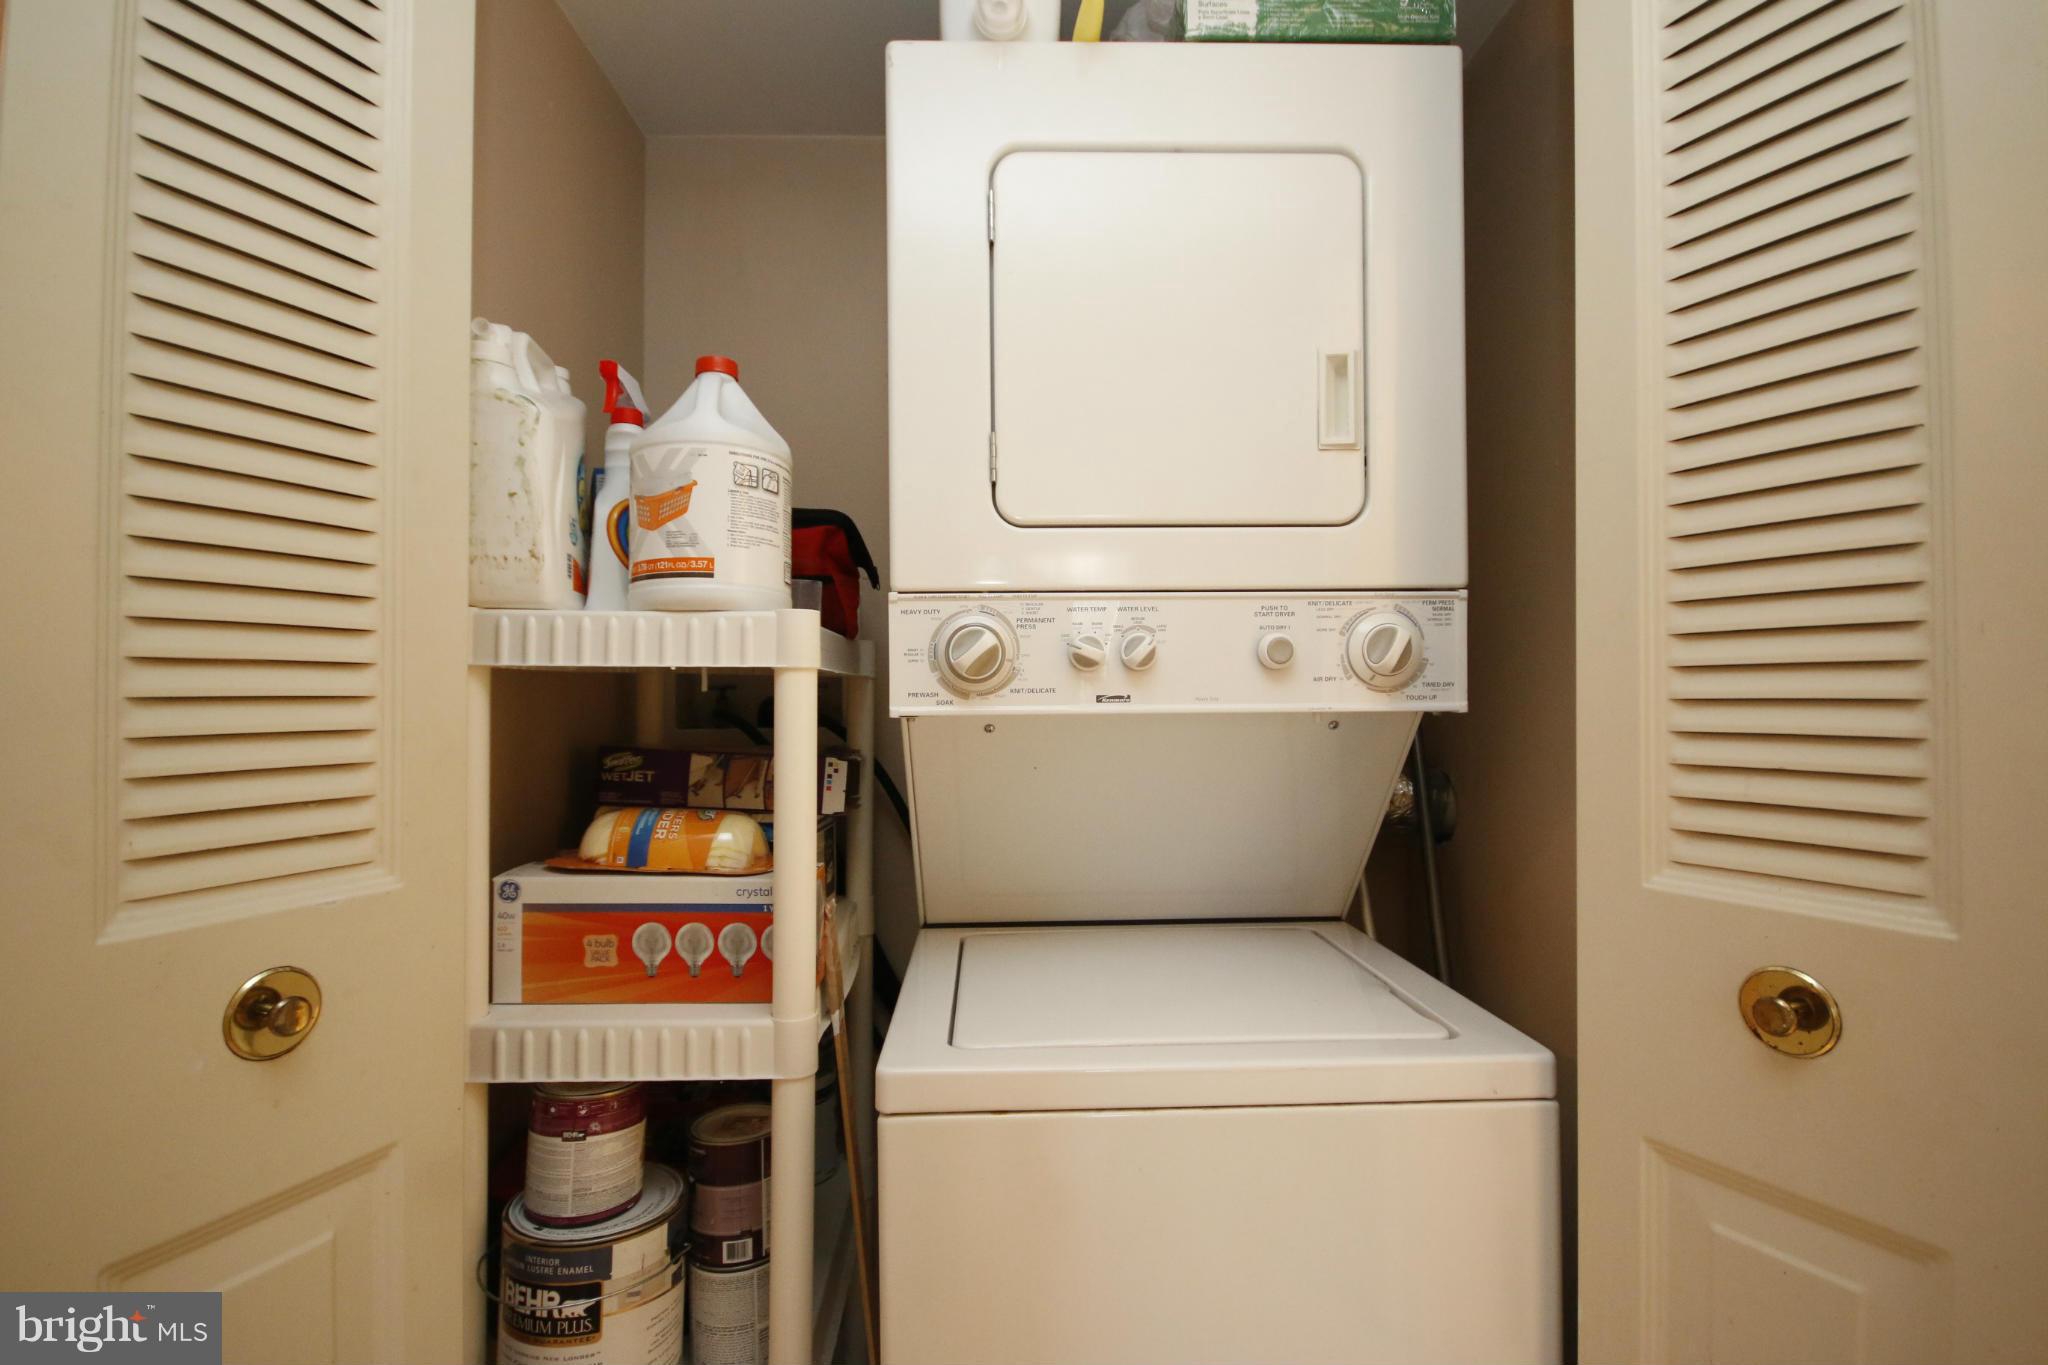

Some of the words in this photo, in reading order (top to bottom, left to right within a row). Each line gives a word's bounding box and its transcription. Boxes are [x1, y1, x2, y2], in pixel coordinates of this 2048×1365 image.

[736, 886, 773, 900] crystal
[557, 1264, 594, 1276] ENAMEL
[504, 1278, 562, 1319] BEHR
[556, 1318, 593, 1336] PLUS
